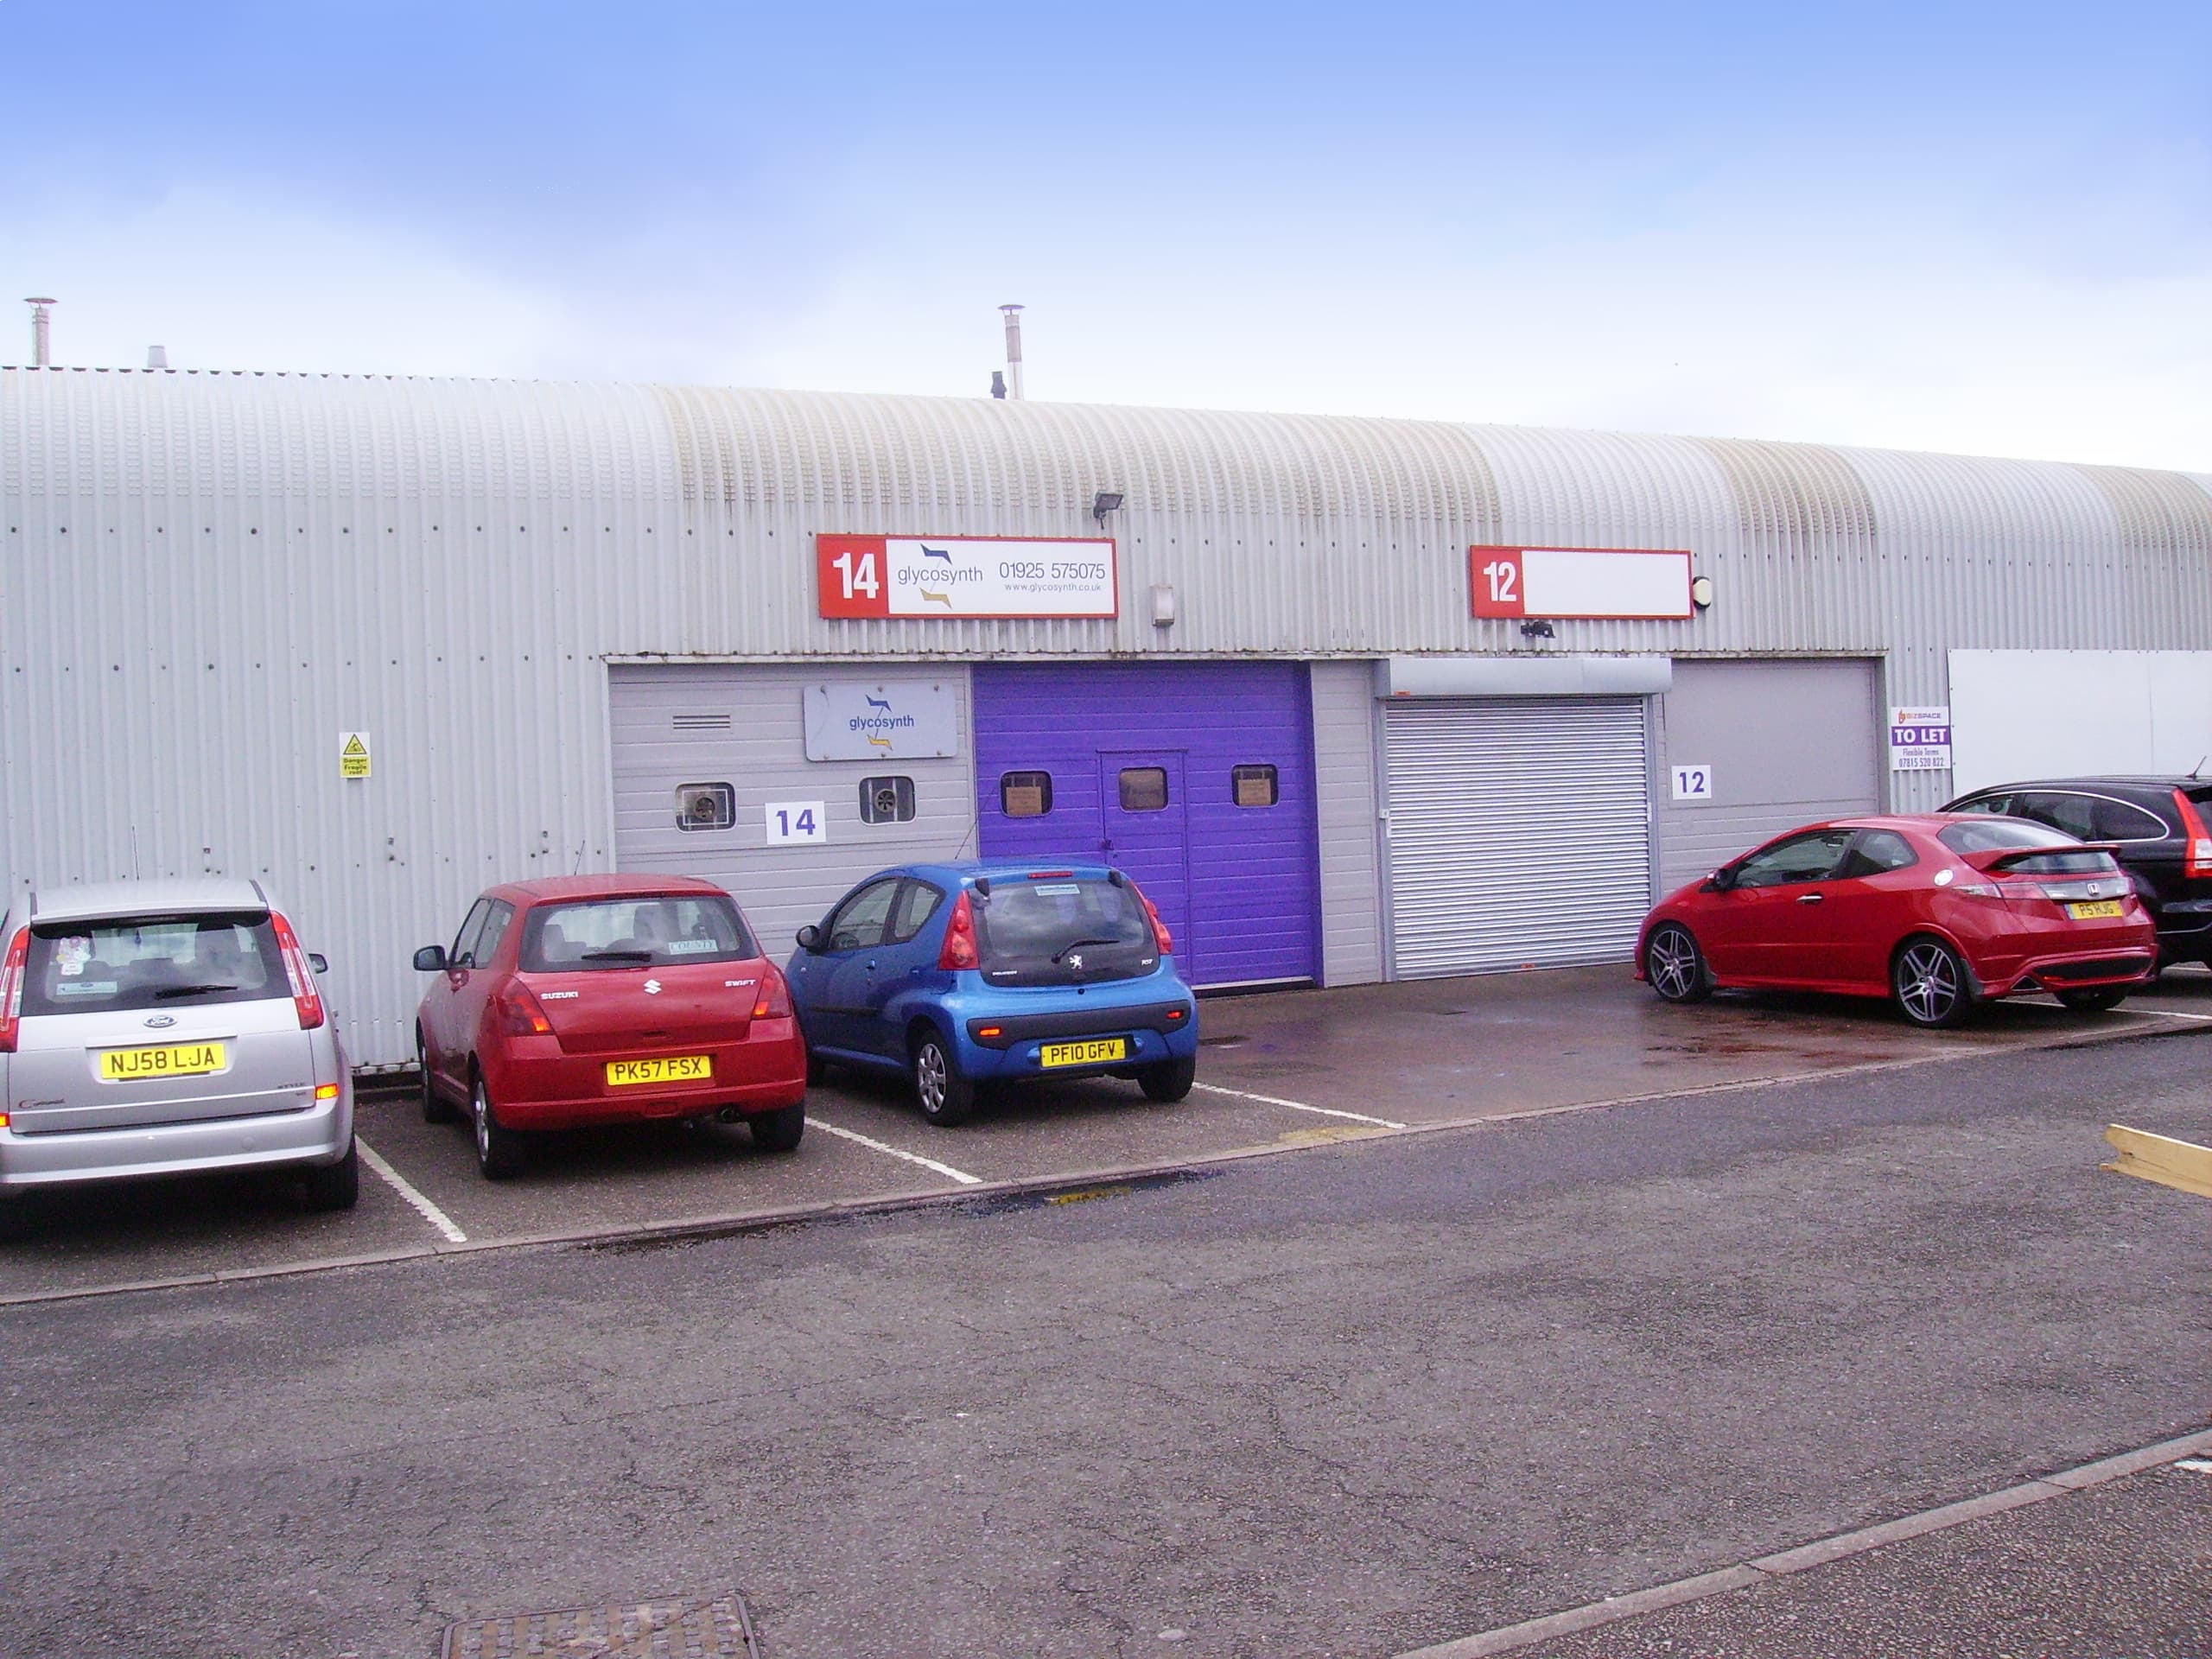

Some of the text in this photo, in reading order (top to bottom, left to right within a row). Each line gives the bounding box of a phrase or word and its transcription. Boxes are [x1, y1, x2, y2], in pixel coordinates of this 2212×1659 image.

[832, 552, 880, 600] 14
[897, 565, 983, 586] glycosynth
[999, 562, 1106, 580] 01925 575075
[1483, 561, 1517, 602] 12
[1004, 582, 1102, 593] www.glycosynth.co.uk
[849, 714, 915, 731] glycosynth
[1894, 728, 1946, 743] TO LET
[1899, 758, 1943, 767] 07815 520 822
[1678, 771, 1705, 793] 12
[776, 808, 817, 837] 14
[724, 979, 756, 988] SWIFT
[540, 991, 579, 1000] SUZUKI
[111, 1046, 216, 1073] NJ58 LJA
[1051, 1042, 1116, 1063] PF10 GFV
[614, 1057, 702, 1081] PK57 FSX
